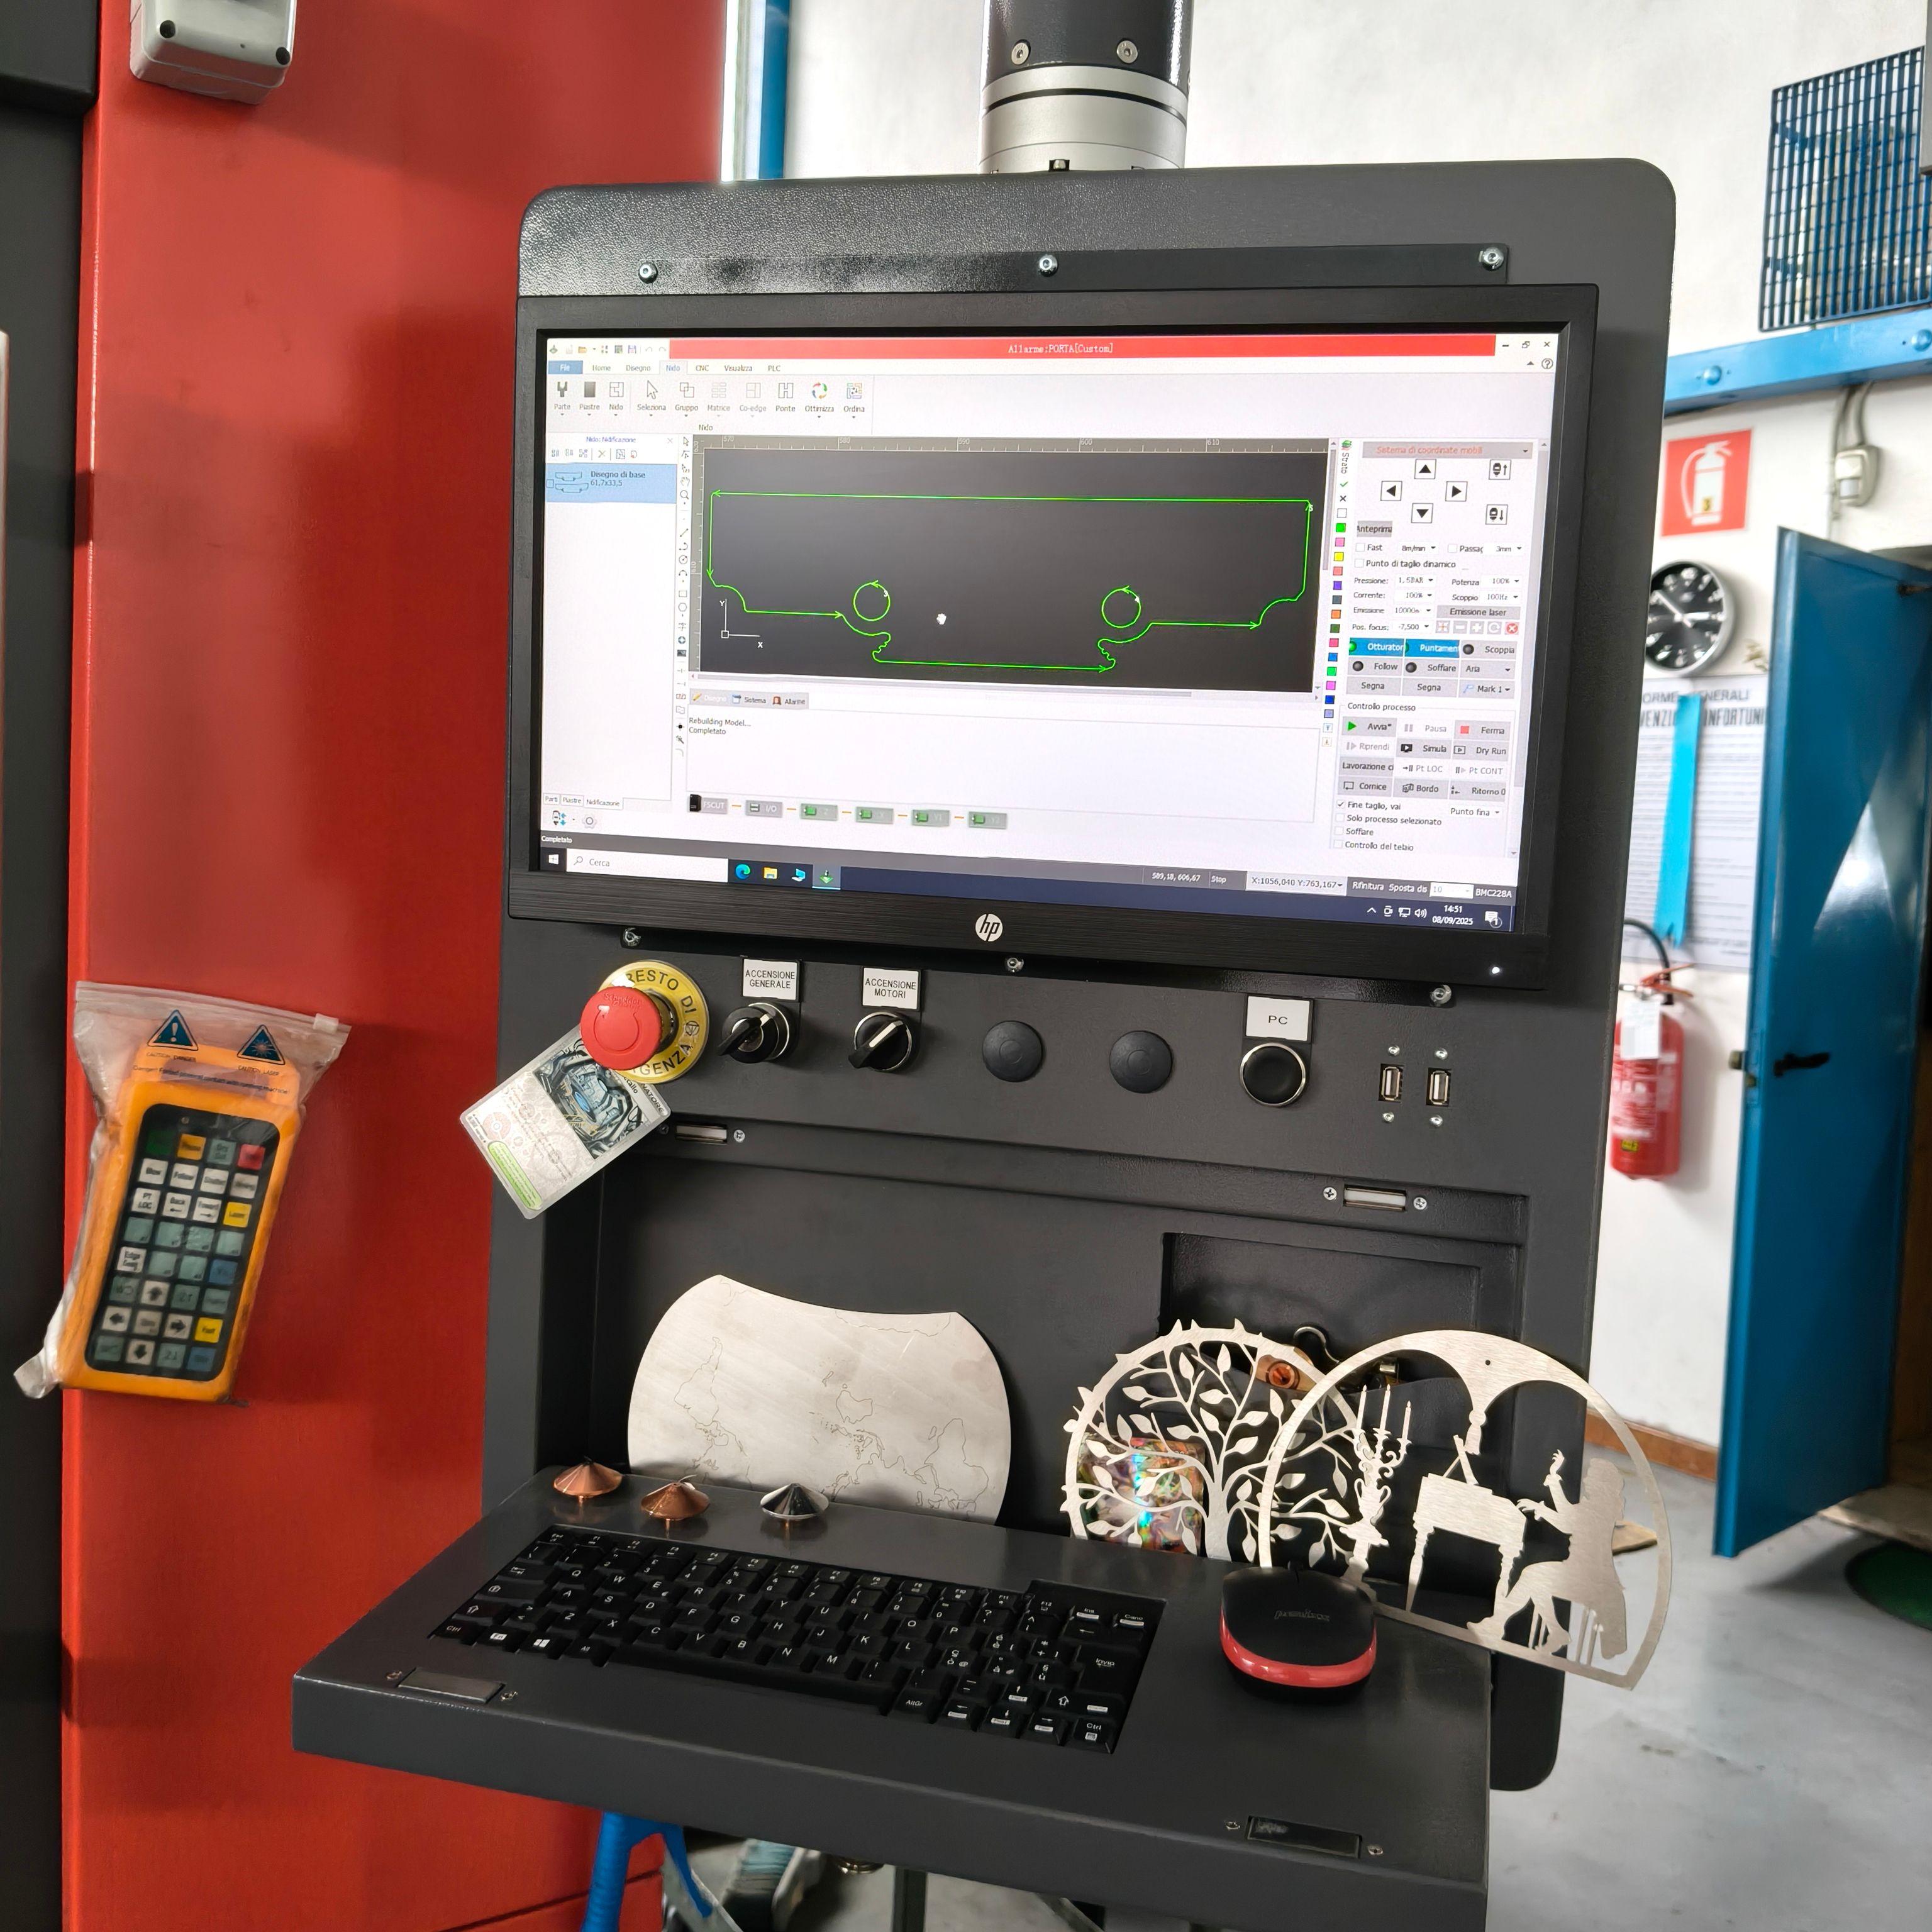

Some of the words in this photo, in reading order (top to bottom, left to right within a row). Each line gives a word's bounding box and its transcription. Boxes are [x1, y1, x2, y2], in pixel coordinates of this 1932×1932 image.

[626, 365, 651, 373] Disegno
[740, 405, 767, 413] Co-edge
[1341, 452, 1349, 474] Strato
[1401, 560, 1420, 569] taglio
[1450, 608, 1486, 616] Emissione
[1489, 608, 1507, 616] laser
[1485, 645, 1515, 655] Scoppia
[1374, 663, 1398, 671] Follow
[1428, 664, 1457, 672] Soffiare
[1361, 682, 1385, 691] Segna
[1417, 684, 1441, 692] Segna
[1477, 685, 1496, 693] Mark
[1642, 691, 1678, 703] ORME
[1383, 704, 1416, 712] processo
[689, 717, 723, 727] Rebuilding
[724, 719, 752, 727] Model...
[689, 727, 726, 735] Completato
[1359, 742, 1390, 752] Riprendi
[1423, 745, 1447, 753] Simula
[1476, 747, 1489, 756] Dry
[1491, 747, 1507, 755] Run
[1342, 762, 1385, 771] Lavorazione
[1416, 765, 1423, 773] Pt
[1426, 765, 1443, 774] LOC
[1469, 767, 1477, 775] Pt
[1480, 767, 1504, 775] CONT
[1359, 782, 1387, 791] Cornice
[1416, 785, 1439, 793] Bordo
[1472, 787, 1499, 796] Ritorno
[704, 801, 725, 809] FSCUT
[765, 804, 777, 813] I/O
[1365, 802, 1388, 811] taglio,
[1450, 808, 1474, 816] Punto
[1476, 808, 1491, 816] fina
[1346, 814, 1363, 823] Solo
[1365, 816, 1398, 825] processo
[1400, 817, 1442, 826] selezionato
[1346, 828, 1374, 836] Soffiare
[1345, 841, 1377, 850] Controllo
[589, 858, 610, 867] Cerca
[1211, 875, 1226, 884] Stop
[1252, 877, 1295, 886] X:1056,040
[1297, 879, 1336, 891] Y:763,167
[1389, 883, 1415, 893] Sposta
[1433, 885, 1442, 893] 10
[1475, 888, 1513, 898] BMC228A
[1444, 904, 1463, 913] 14:51
[1432, 915, 1474, 926] 08/09/2025
[979, 914, 1000, 941] hp
[745, 970, 796, 979] ACCENSIONE
[749, 979, 791, 989] GENERALE
[865, 978, 916, 990] ACCENSIONE
[874, 989, 906, 999] MOTORI
[680, 996, 697, 1014] DI
[1268, 1014, 1288, 1026] PC
[782, 1648, 792, 1656] N
[827, 1655, 838, 1664] M
[1096, 1658, 1115, 1666] Invio
